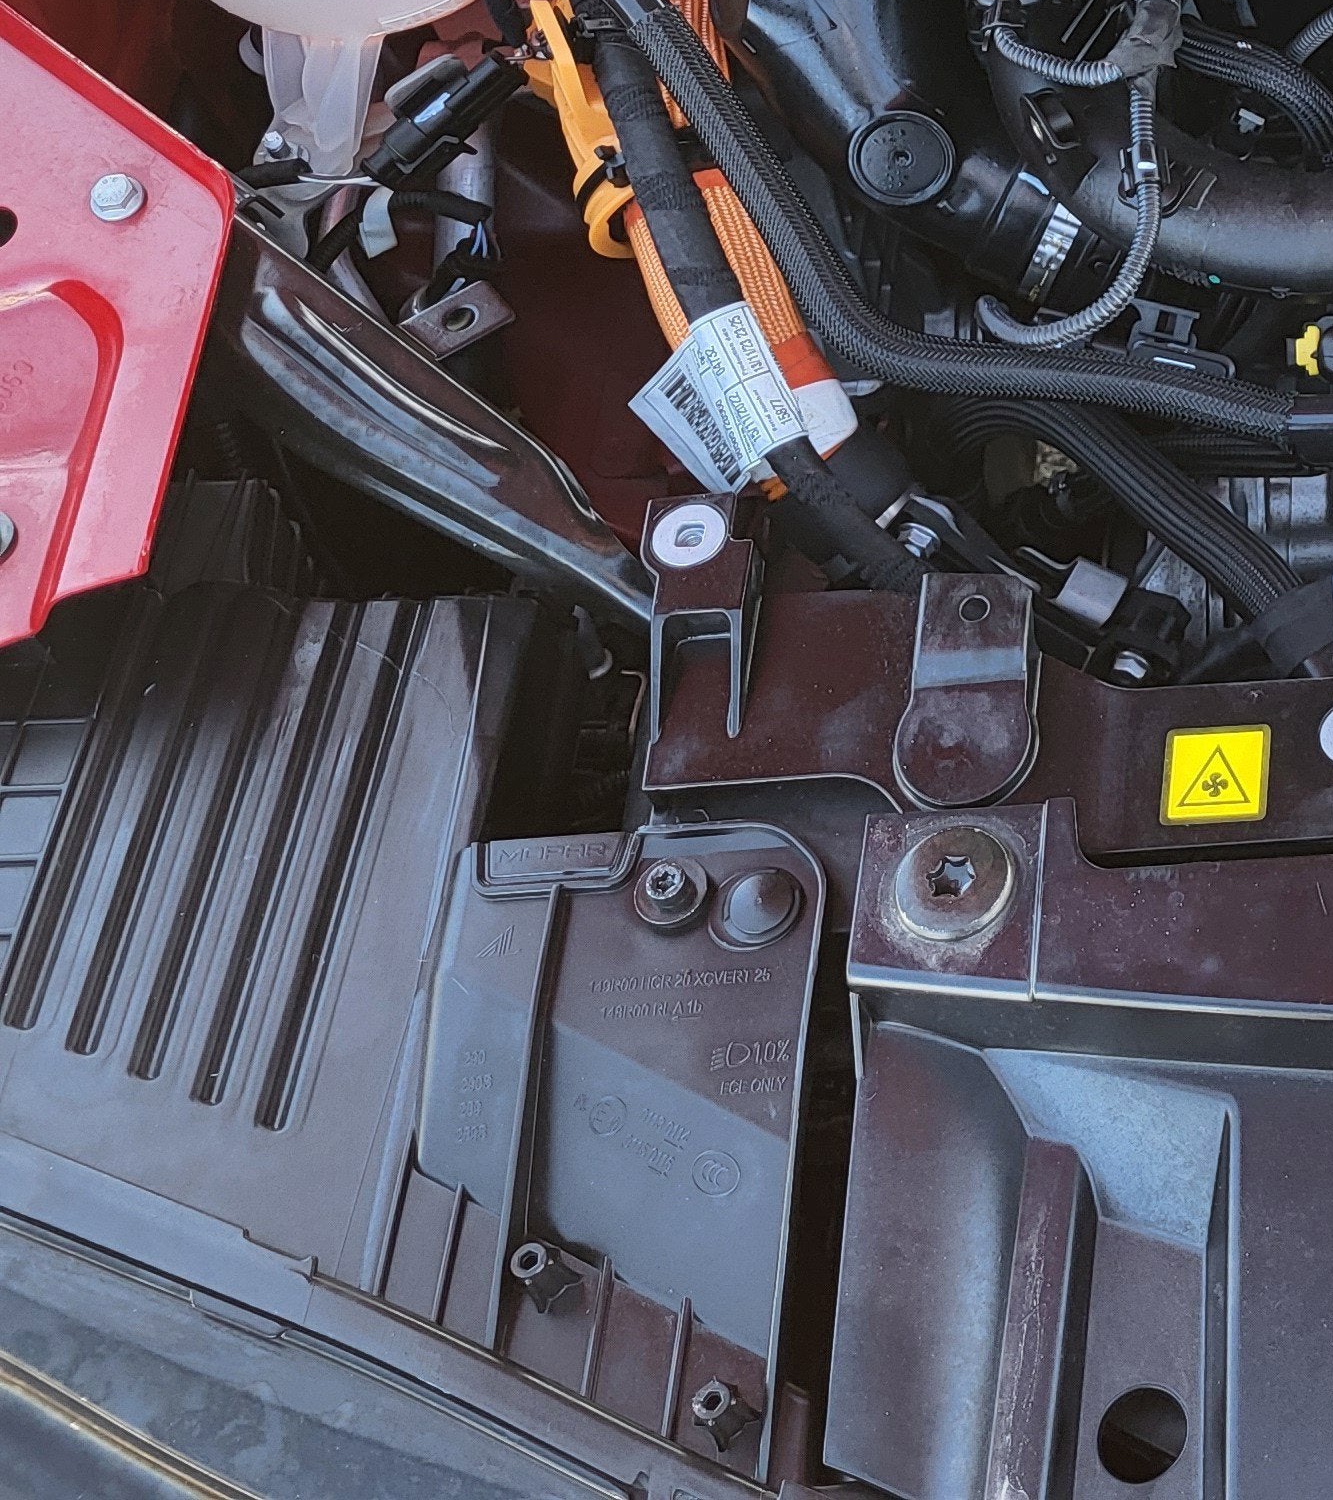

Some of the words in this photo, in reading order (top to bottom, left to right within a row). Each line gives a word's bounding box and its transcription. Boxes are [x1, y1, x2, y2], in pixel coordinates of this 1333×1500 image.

[770, 397, 793, 426] 15877
[499, 841, 606, 863] MOPAR
[750, 1077, 787, 1094] ONLY
